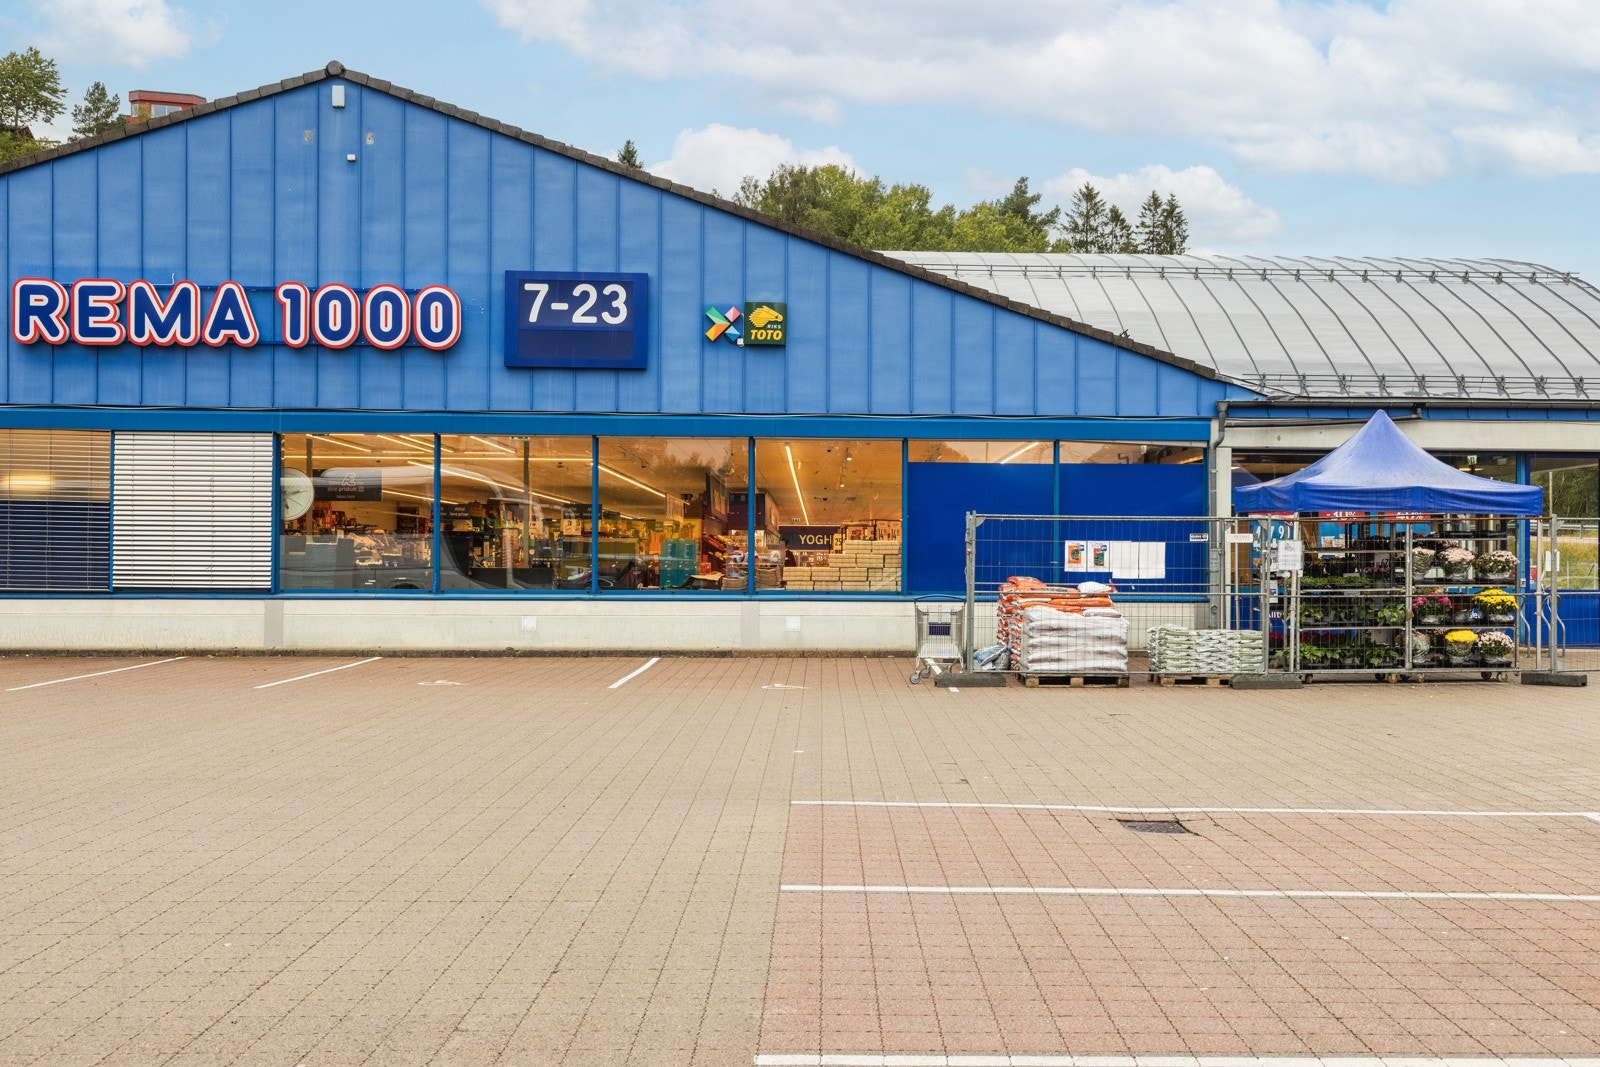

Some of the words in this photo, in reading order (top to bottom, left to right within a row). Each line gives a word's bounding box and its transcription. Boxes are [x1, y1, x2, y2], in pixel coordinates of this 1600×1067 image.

[12, 277, 260, 347] REMA
[276, 281, 462, 351] 1000
[523, 283, 628, 325] 7-23
[750, 330, 782, 341] TOTO
